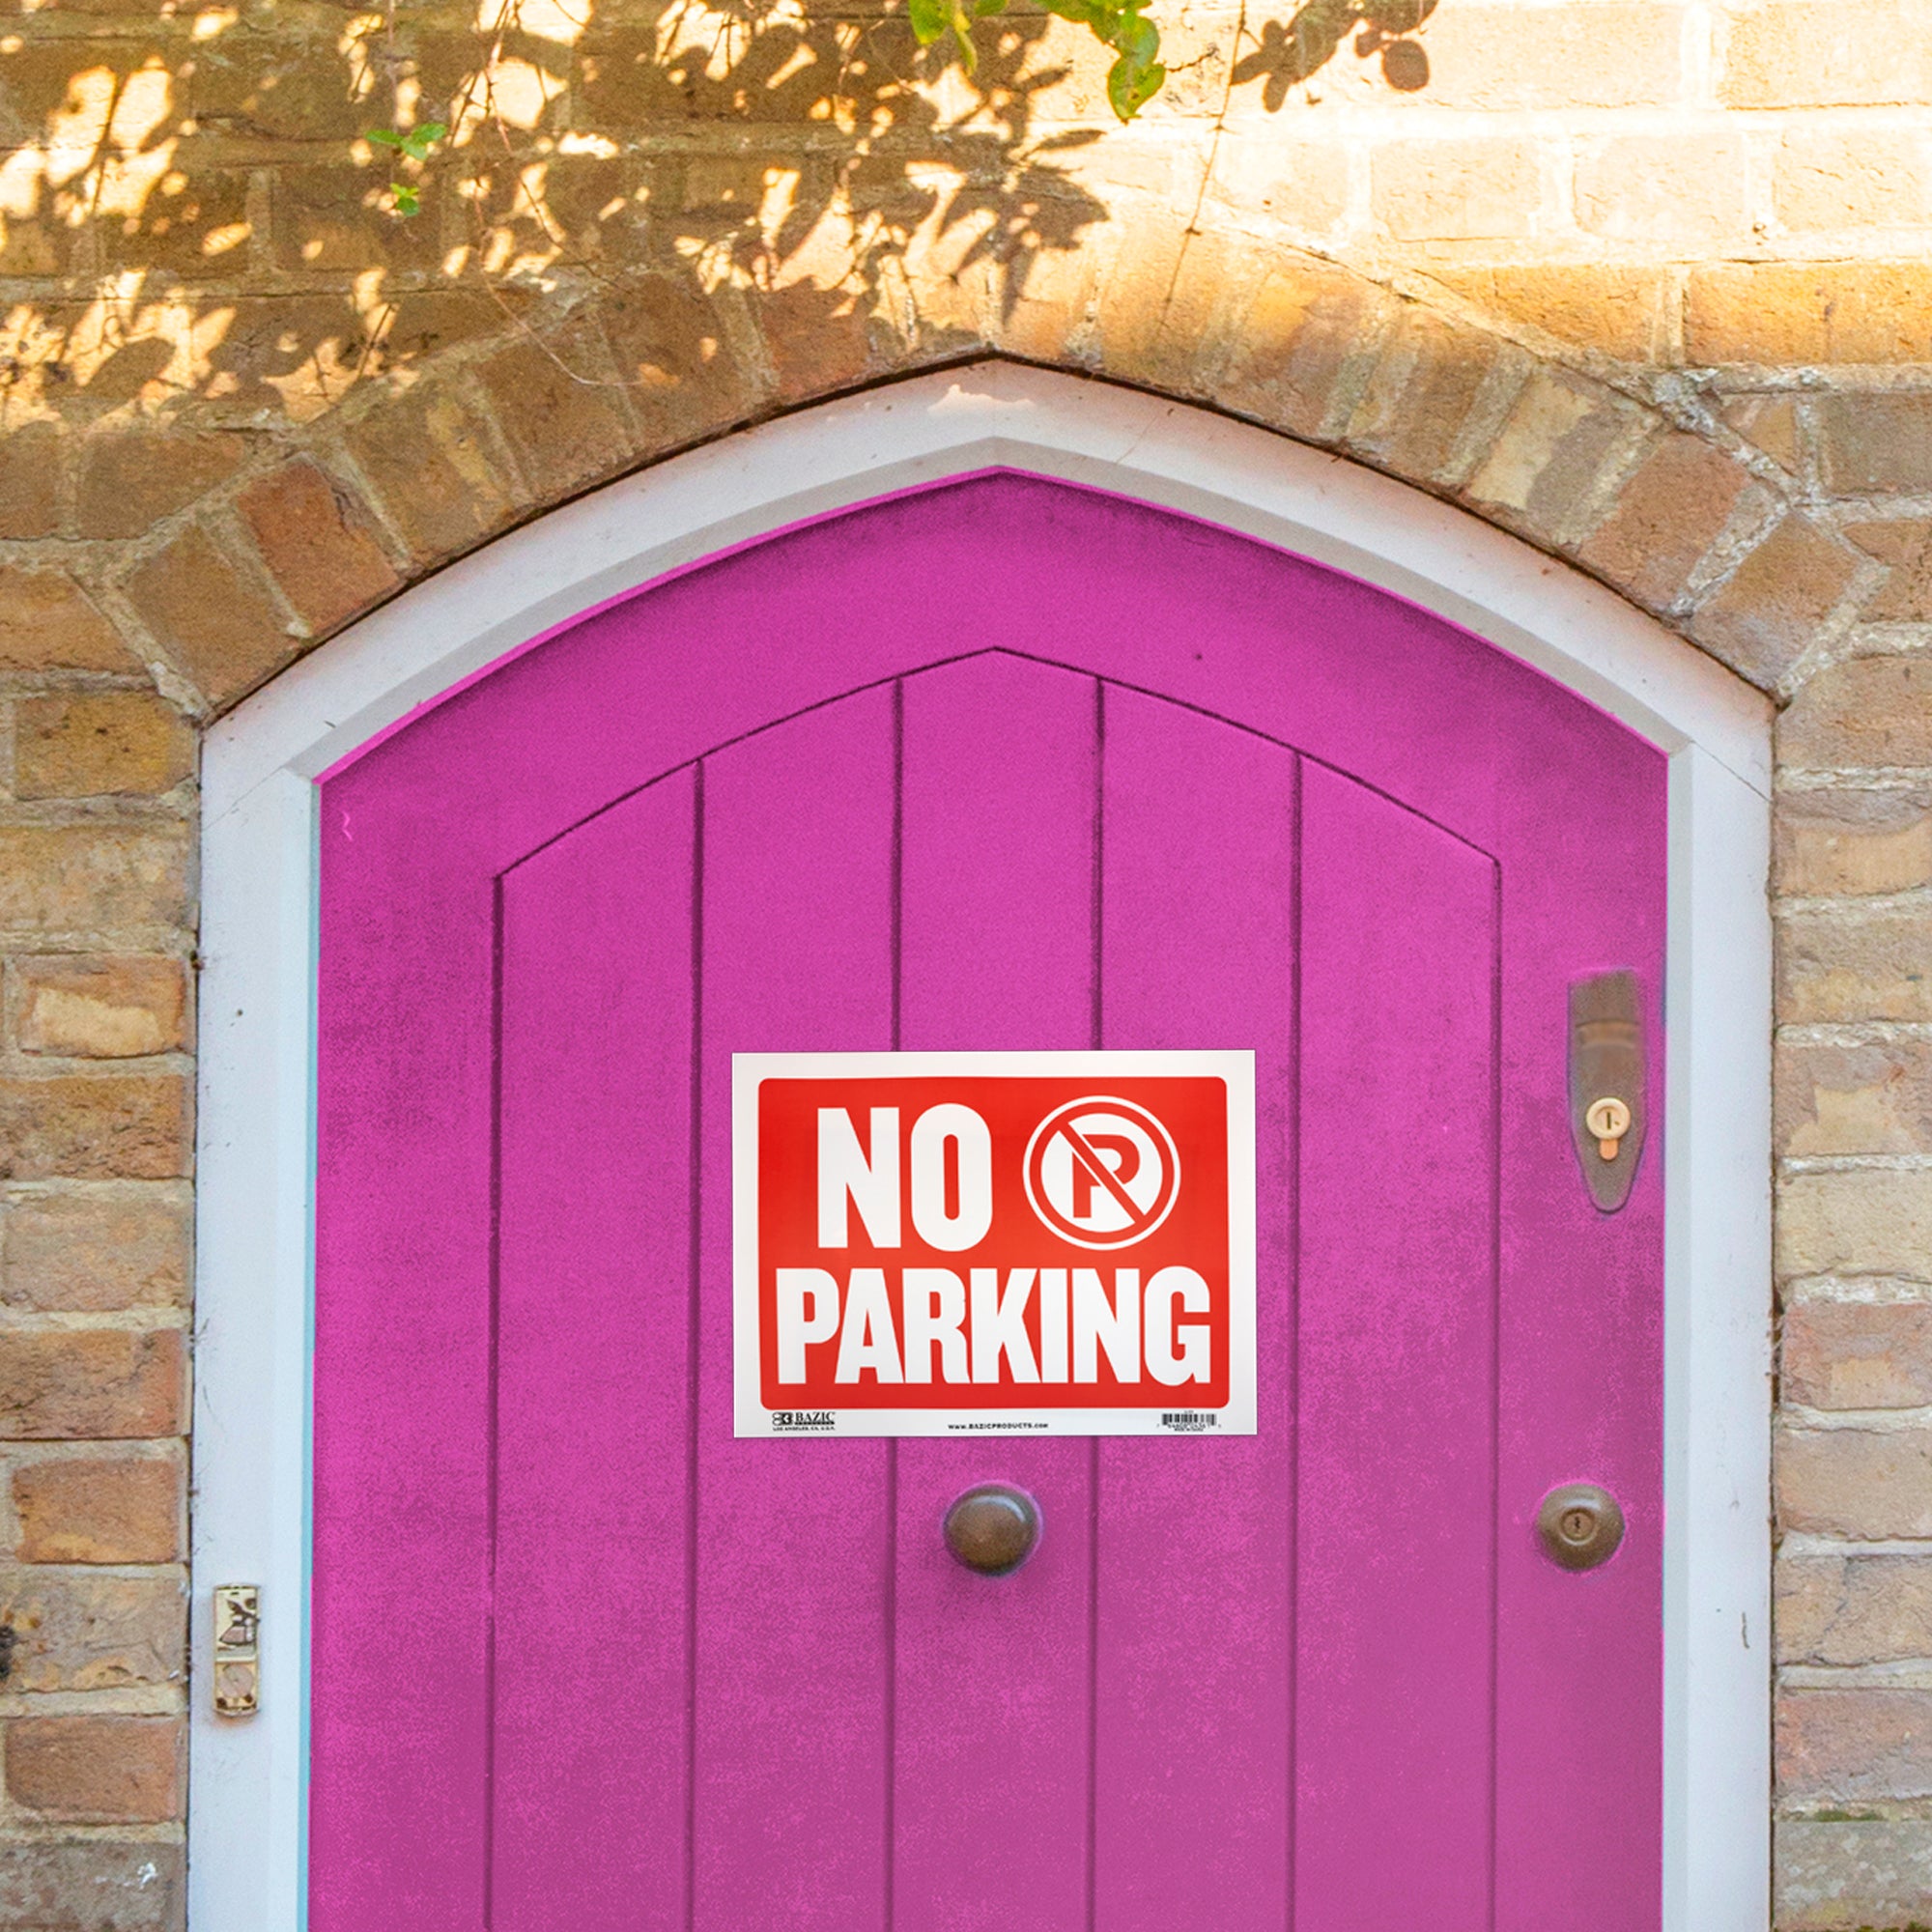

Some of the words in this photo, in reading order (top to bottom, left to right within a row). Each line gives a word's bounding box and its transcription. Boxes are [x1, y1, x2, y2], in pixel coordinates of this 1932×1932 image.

[817, 1103, 993, 1252] NO
[1072, 1134, 1141, 1218] P
[776, 1265, 1211, 1385] PARKING
[795, 1411, 836, 1421] BAZIC
